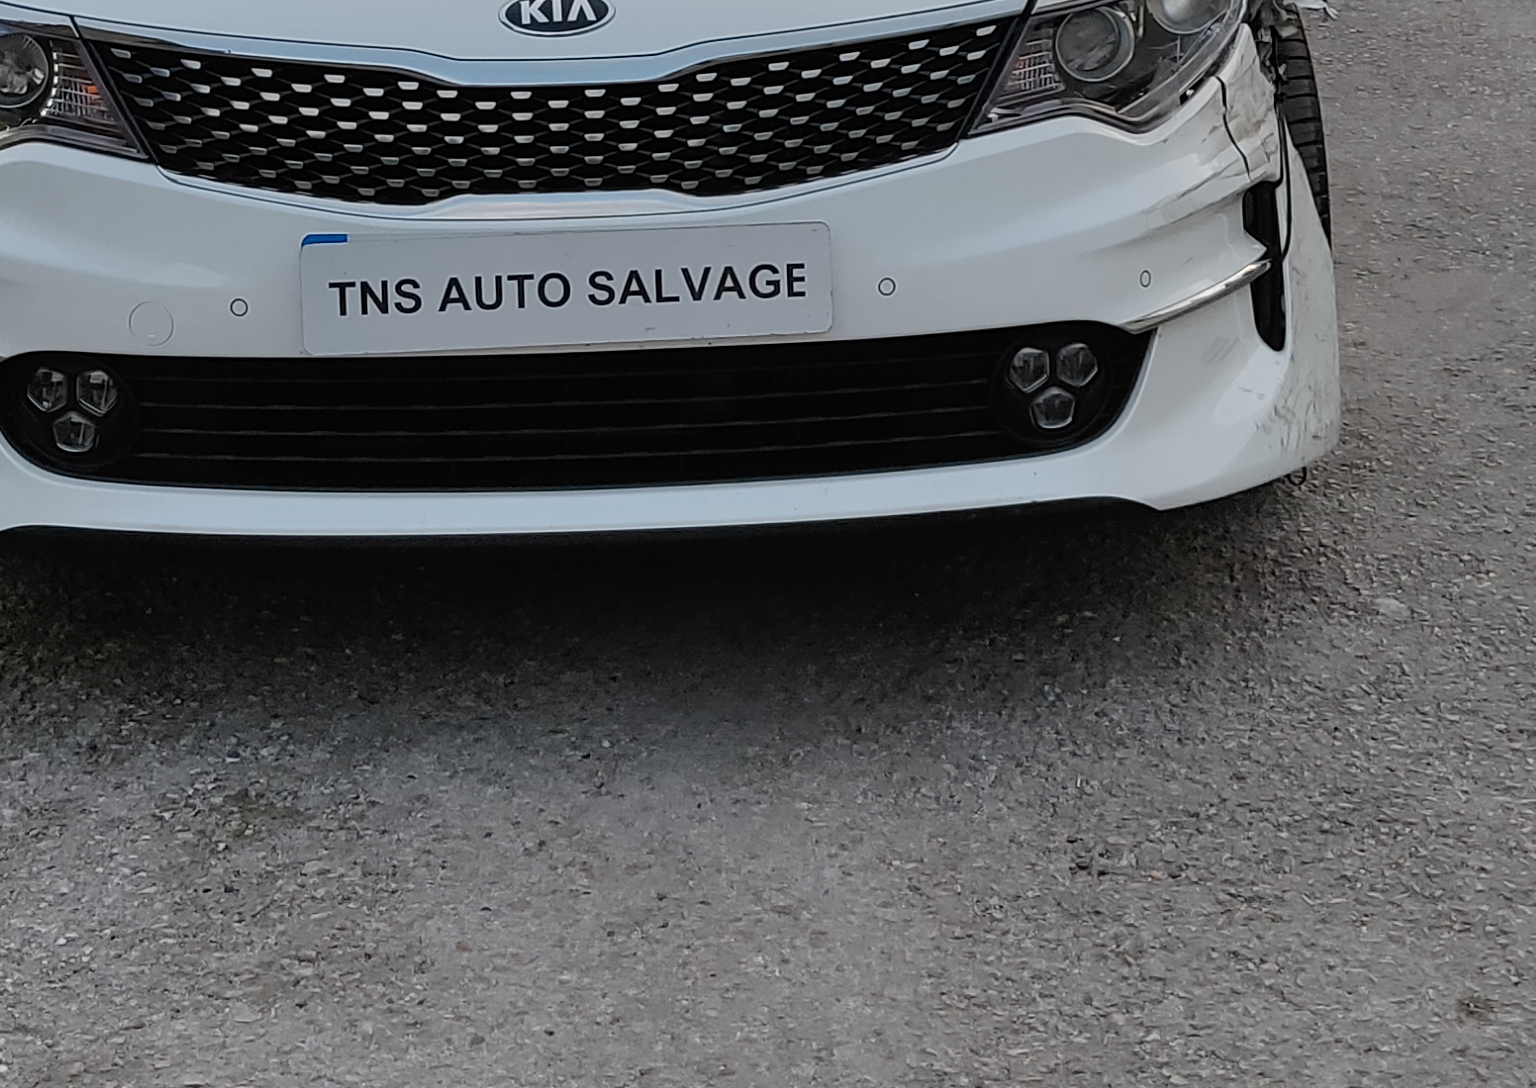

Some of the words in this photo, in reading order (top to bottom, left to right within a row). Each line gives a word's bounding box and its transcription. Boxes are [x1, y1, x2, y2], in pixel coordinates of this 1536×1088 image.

[328, 277, 423, 317] TNS
[438, 272, 571, 312] AUTO
[587, 262, 807, 306] SALVAGE
